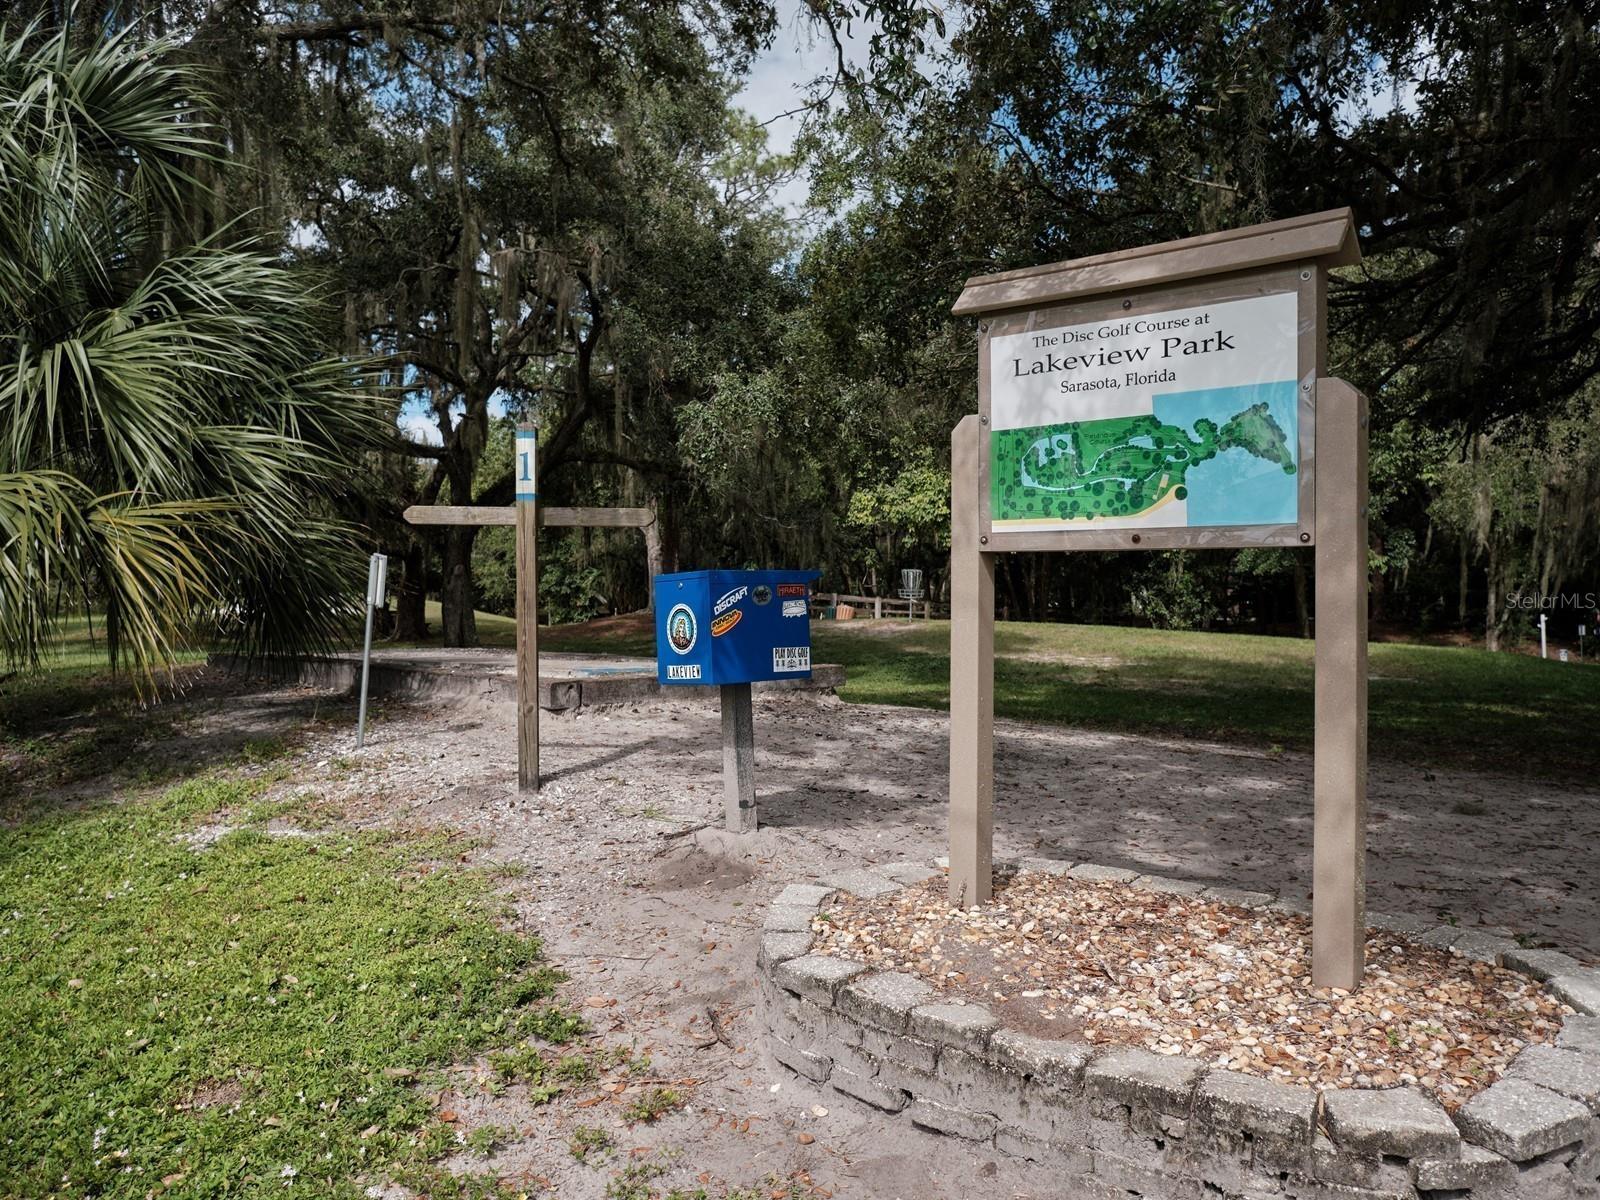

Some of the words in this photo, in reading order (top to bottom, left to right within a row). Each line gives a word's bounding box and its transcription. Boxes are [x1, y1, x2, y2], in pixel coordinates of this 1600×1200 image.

[1032, 336, 1059, 348] The
[1062, 331, 1094, 344] Disc
[1098, 323, 1131, 339] Golf
[1134, 318, 1190, 334] Course
[1195, 312, 1210, 325] at
[1013, 346, 1151, 377] Lakeview
[1160, 330, 1236, 359] Park
[1060, 377, 1121, 394] Sarasota,
[1125, 369, 1177, 387] Florida
[519, 452, 532, 481] 1
[714, 586, 747, 615] DISCRAFT
[668, 665, 700, 678] LAKEVIEW
